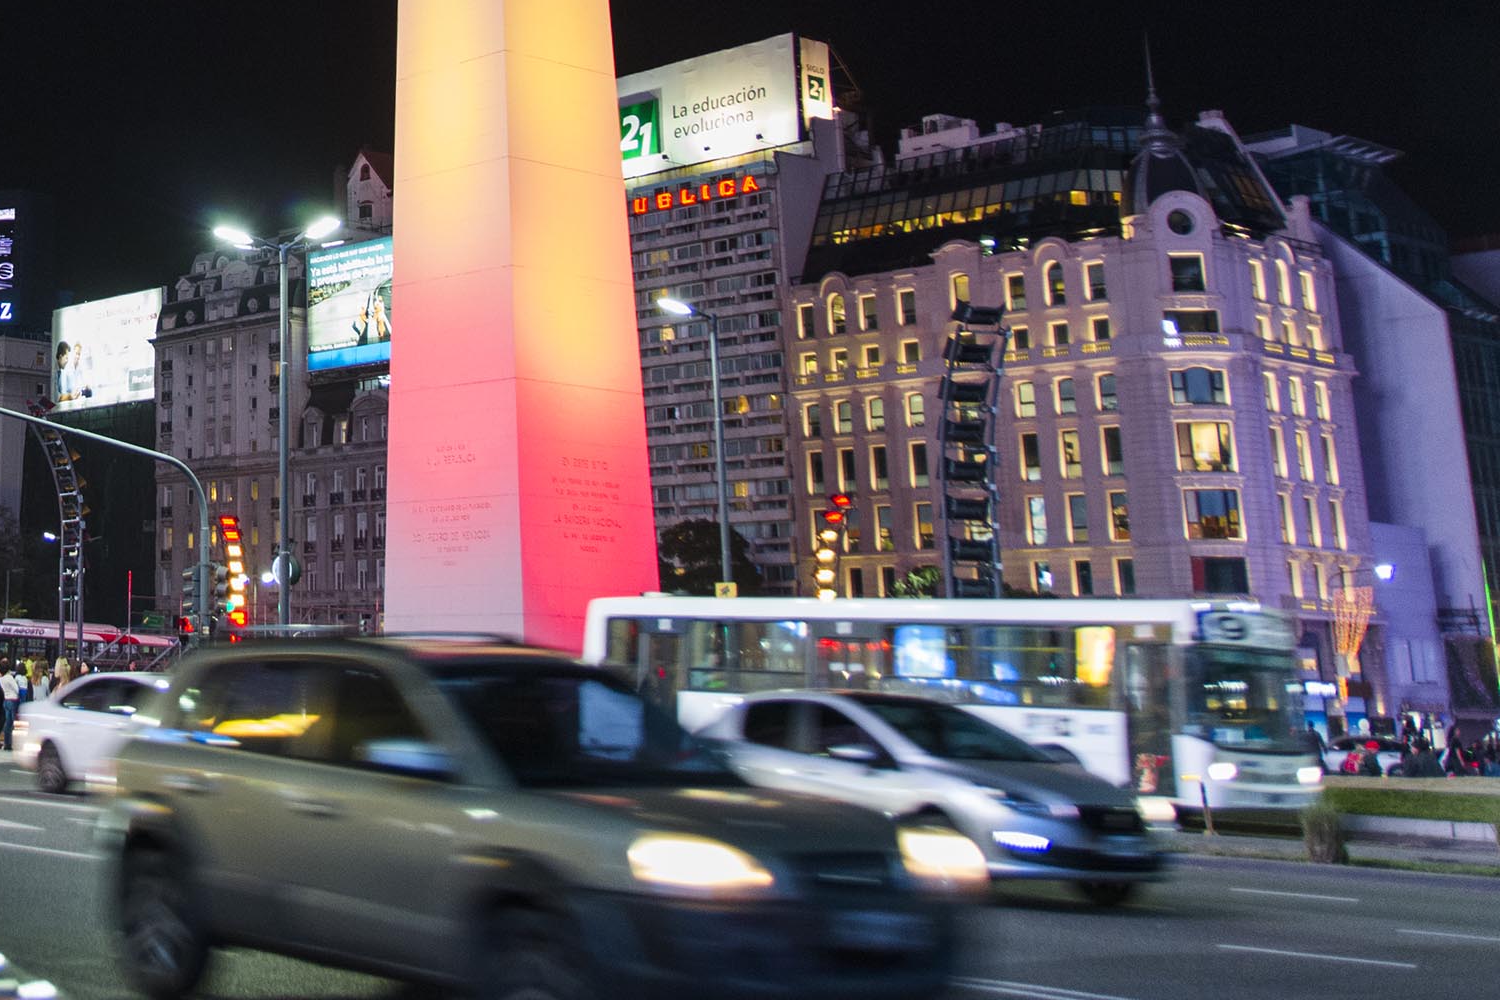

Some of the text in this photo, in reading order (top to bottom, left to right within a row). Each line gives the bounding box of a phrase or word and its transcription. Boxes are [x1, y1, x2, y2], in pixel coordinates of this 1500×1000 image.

[806, 63, 825, 75] SIGLO
[672, 85, 766, 119] La educación
[809, 79, 824, 101] 21
[620, 114, 653, 157] 21
[674, 109, 754, 139] evoluciona
[310, 266, 321, 278] Ya
[13, 627, 45, 636] AGOSTO
[1218, 615, 1247, 641] 9
